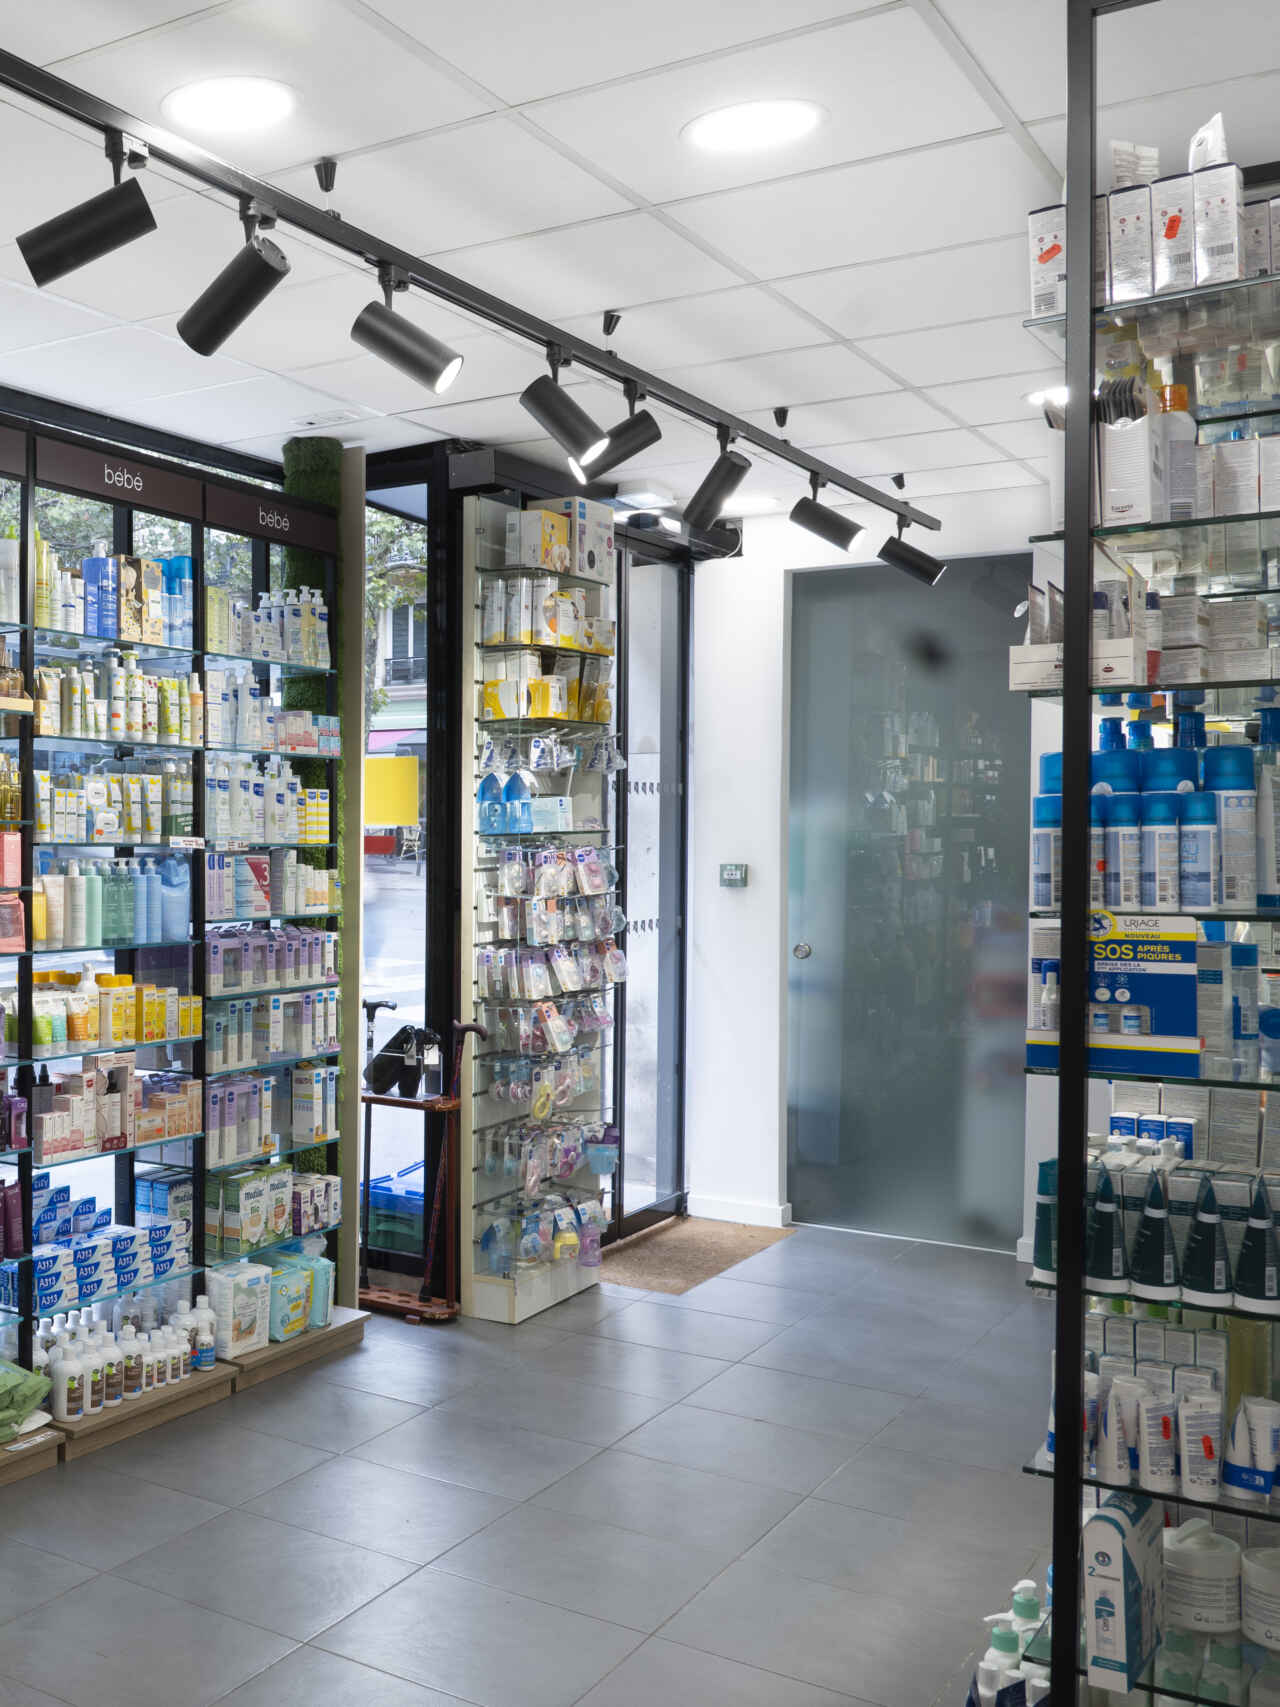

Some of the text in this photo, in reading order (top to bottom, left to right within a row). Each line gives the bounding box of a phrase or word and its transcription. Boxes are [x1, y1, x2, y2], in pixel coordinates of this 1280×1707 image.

[104, 464, 143, 492] bébé
[259, 505, 290, 532] bébé
[1124, 919, 1160, 928] URIAGE
[1094, 943, 1134, 960] SOS
[151, 1228, 166, 1239] A313
[76, 1248, 92, 1260] A313
[37, 1259, 54, 1270] A313
[79, 1265, 94, 1276] A313
[39, 1276, 56, 1287] A313
[120, 1273, 134, 1283] A313
[81, 1283, 98, 1294] A313
[41, 1294, 58, 1305] A313
